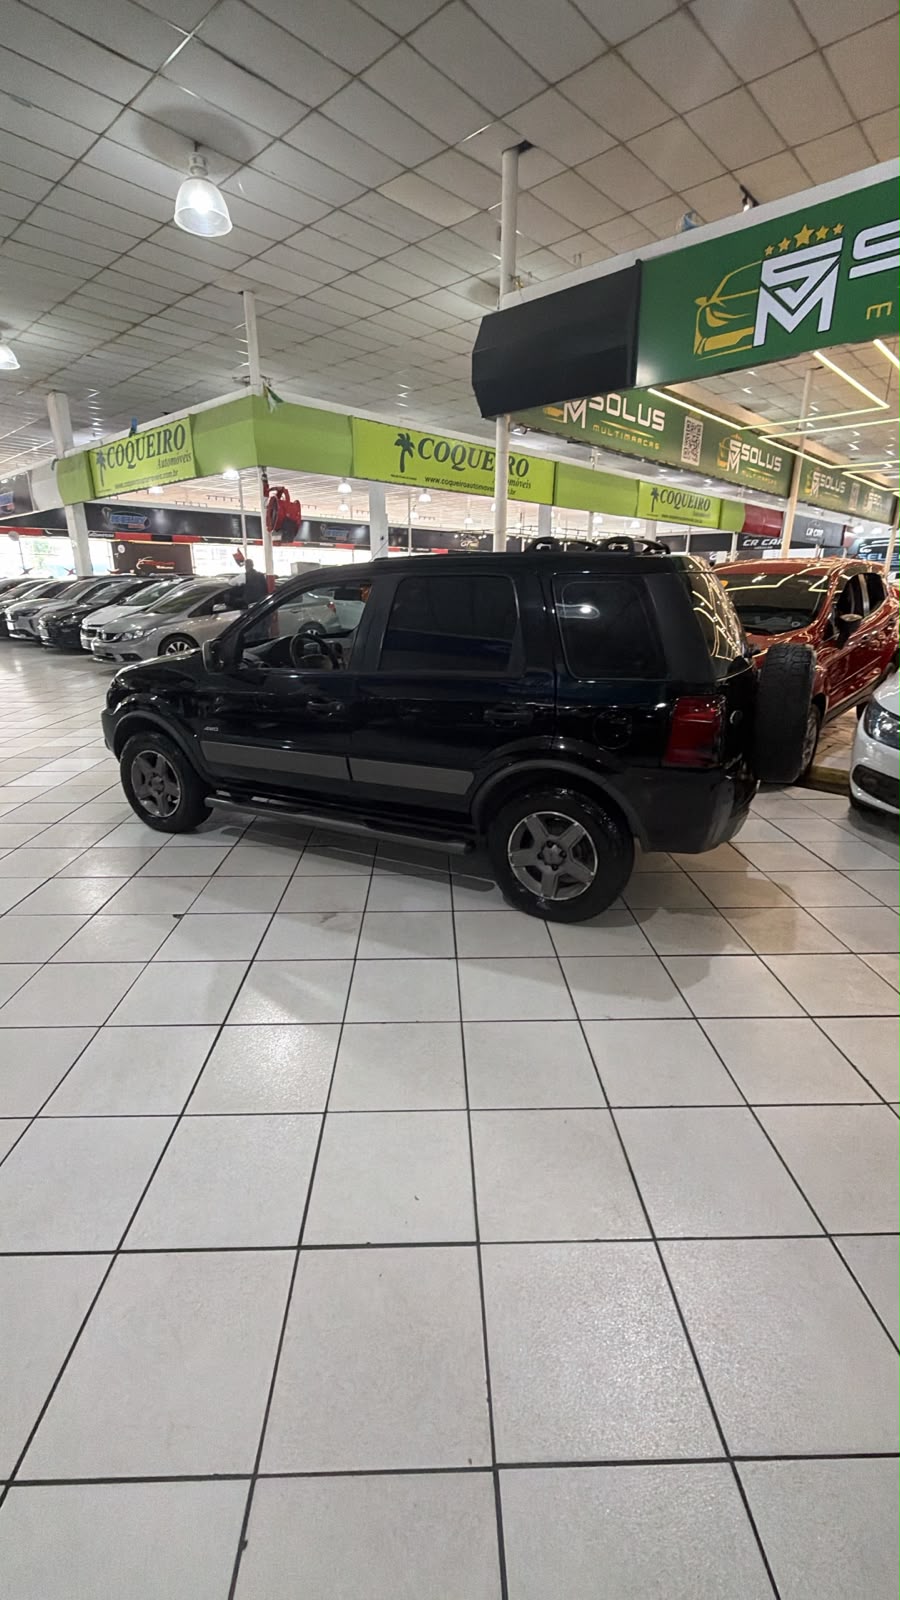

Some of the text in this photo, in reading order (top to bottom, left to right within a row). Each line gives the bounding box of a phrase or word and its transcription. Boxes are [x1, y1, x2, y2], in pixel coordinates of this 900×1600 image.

[848, 217, 900, 280] S
[588, 392, 666, 432] SOLUS
[107, 424, 187, 470] COQUEIRO
[417, 437, 530, 478] COQUERO
[741, 443, 783, 473] SOLUS
[660, 489, 711, 512] COQUEIRO
[819, 474, 847, 494] SOLUS
[742, 539, 761, 547] CR
